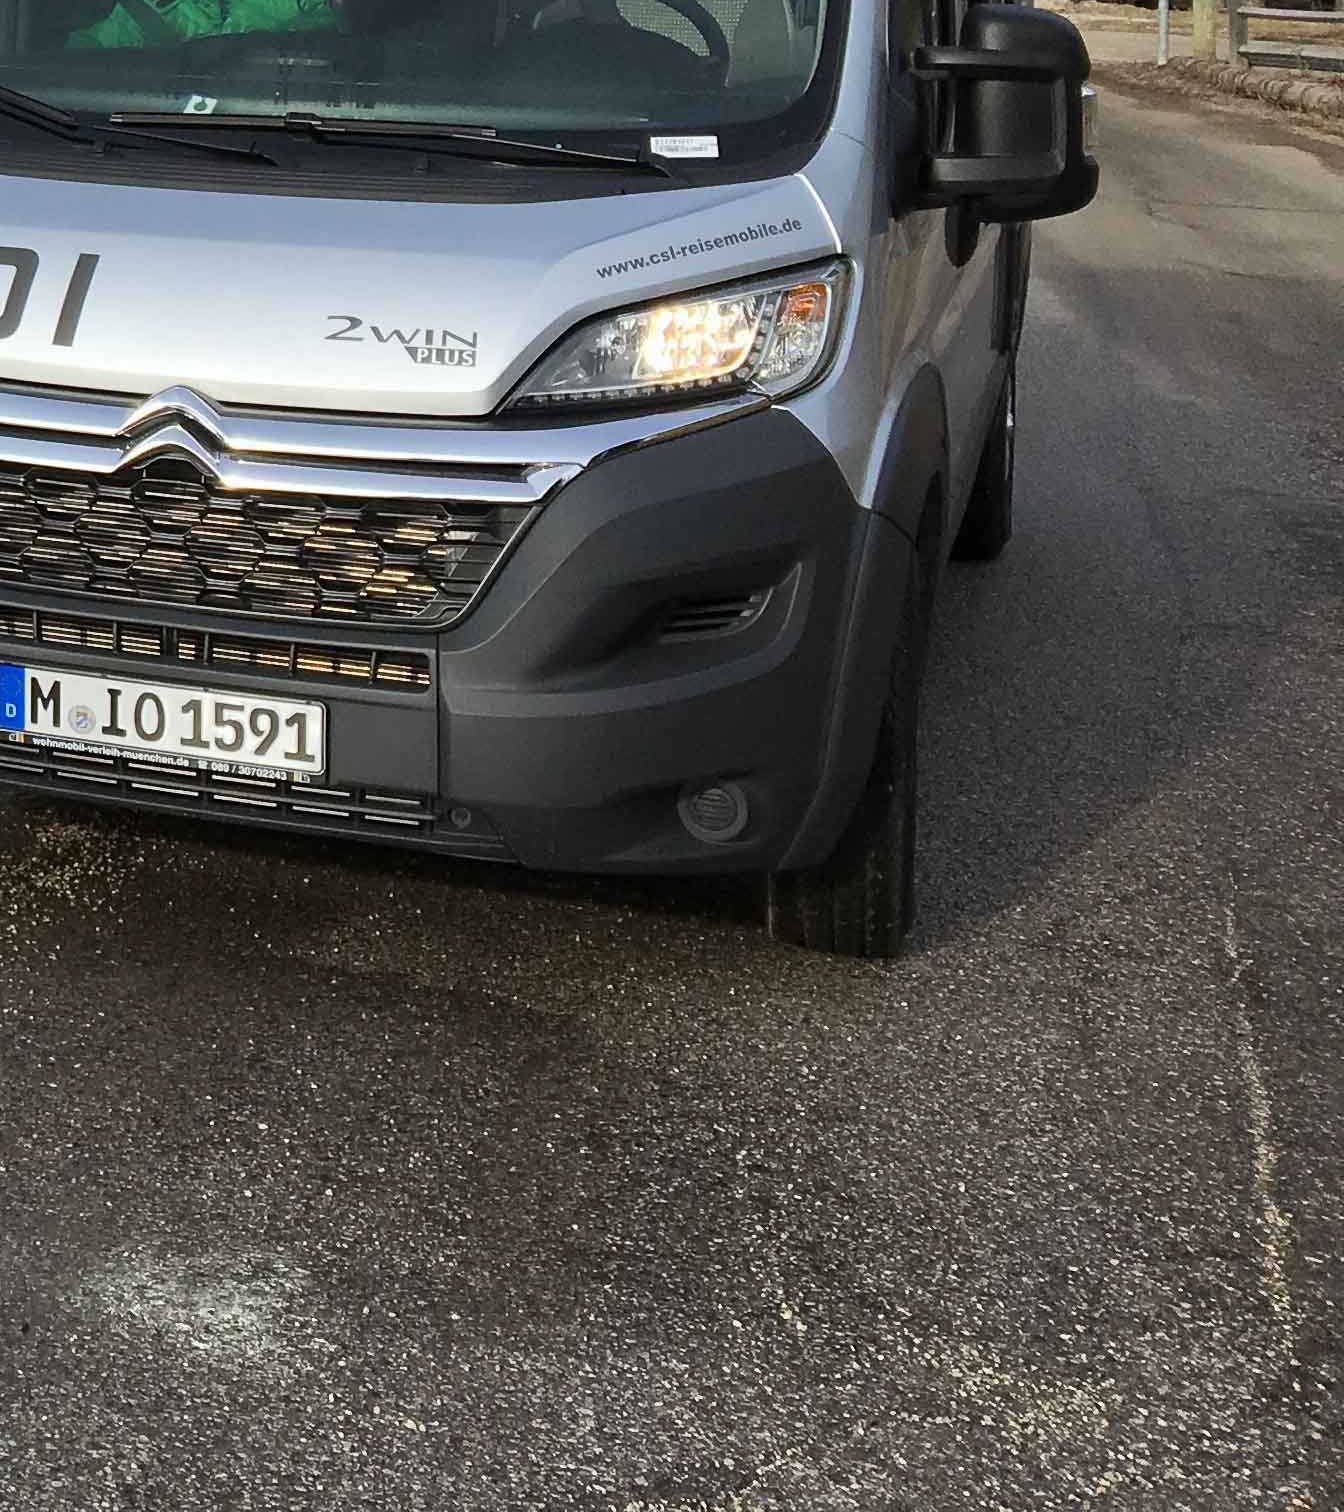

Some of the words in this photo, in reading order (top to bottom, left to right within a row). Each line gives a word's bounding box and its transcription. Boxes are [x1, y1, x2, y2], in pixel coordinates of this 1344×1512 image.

[596, 216, 803, 279] www.csl-reisemobile.de
[417, 347, 475, 367] PLUS
[5, 703, 17, 718] D
[30, 676, 62, 729] M
[179, 698, 316, 763] 1591
[32, 737, 189, 767] wohnmobil-verleih-muenchen.de
